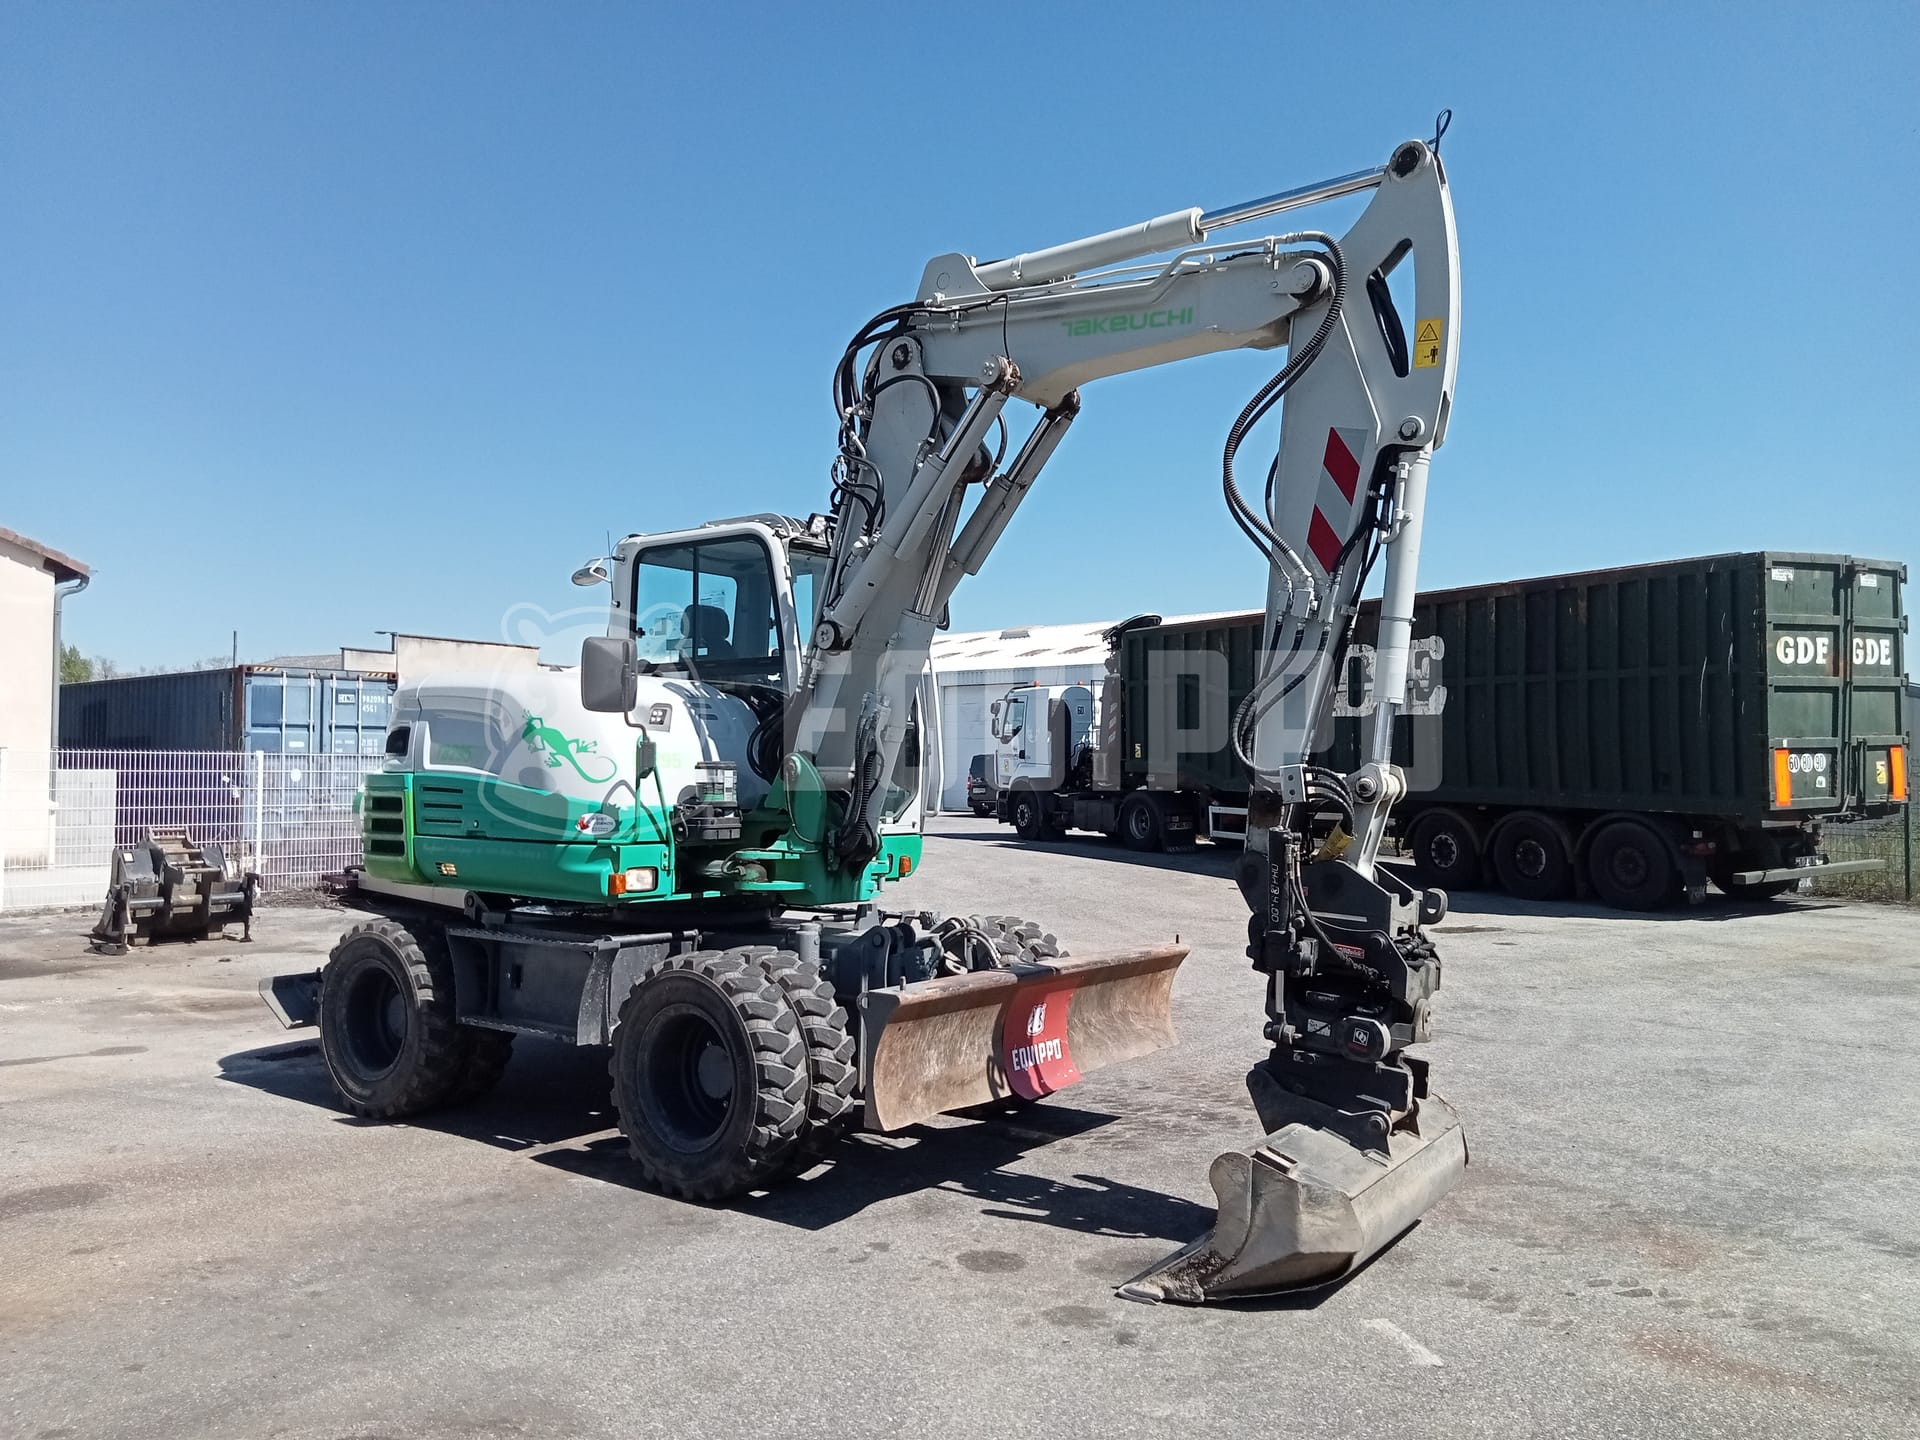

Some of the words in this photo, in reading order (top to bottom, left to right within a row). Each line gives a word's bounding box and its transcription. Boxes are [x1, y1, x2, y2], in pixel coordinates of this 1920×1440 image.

[1061, 306, 1193, 337] TAKEUCHI
[1853, 638, 1891, 665] GDE
[1789, 756, 1799, 770] 60
[1012, 1038, 1062, 1071] EQUIPPO
